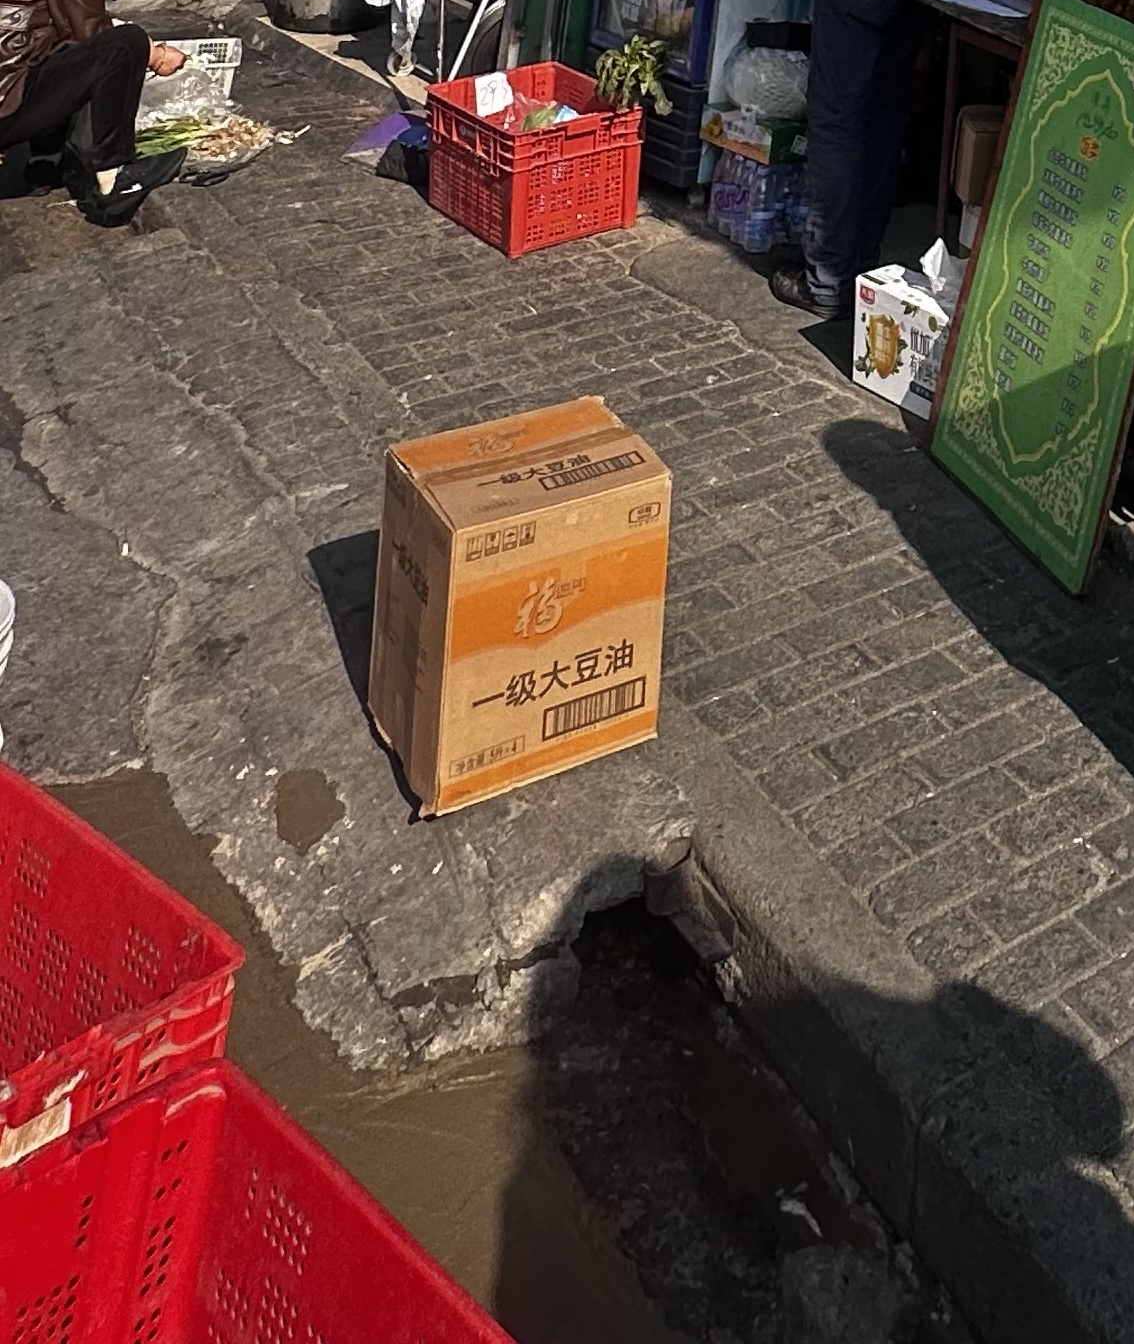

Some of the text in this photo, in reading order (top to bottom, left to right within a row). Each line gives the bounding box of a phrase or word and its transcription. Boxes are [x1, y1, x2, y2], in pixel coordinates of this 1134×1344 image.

[476, 454, 592, 487] 一级大豆油
[472, 638, 635, 708] 一级大豆油
